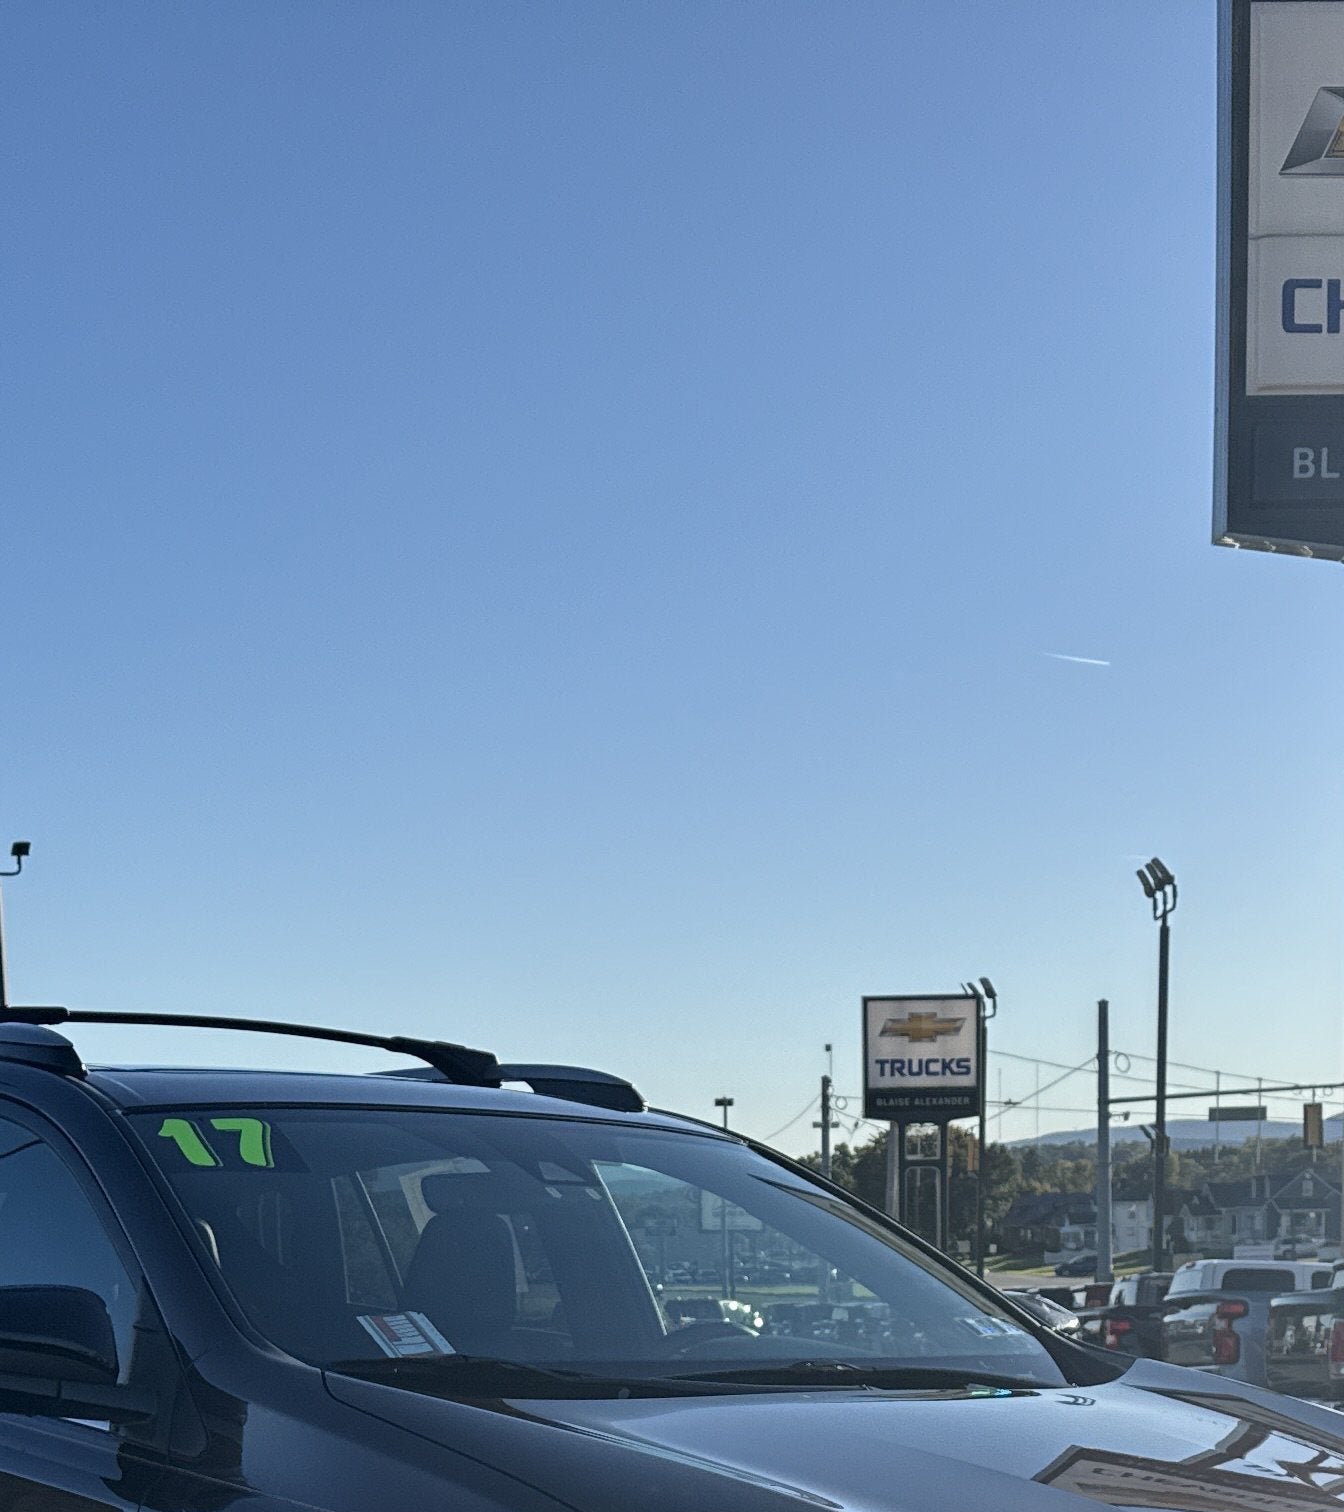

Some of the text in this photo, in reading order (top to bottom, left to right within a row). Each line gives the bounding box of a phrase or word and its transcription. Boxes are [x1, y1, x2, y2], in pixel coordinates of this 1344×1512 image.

[875, 1057, 972, 1078] TRUCKS
[876, 1096, 970, 1107] BLAISE ALEXANDER
[157, 1118, 275, 1168] 17
